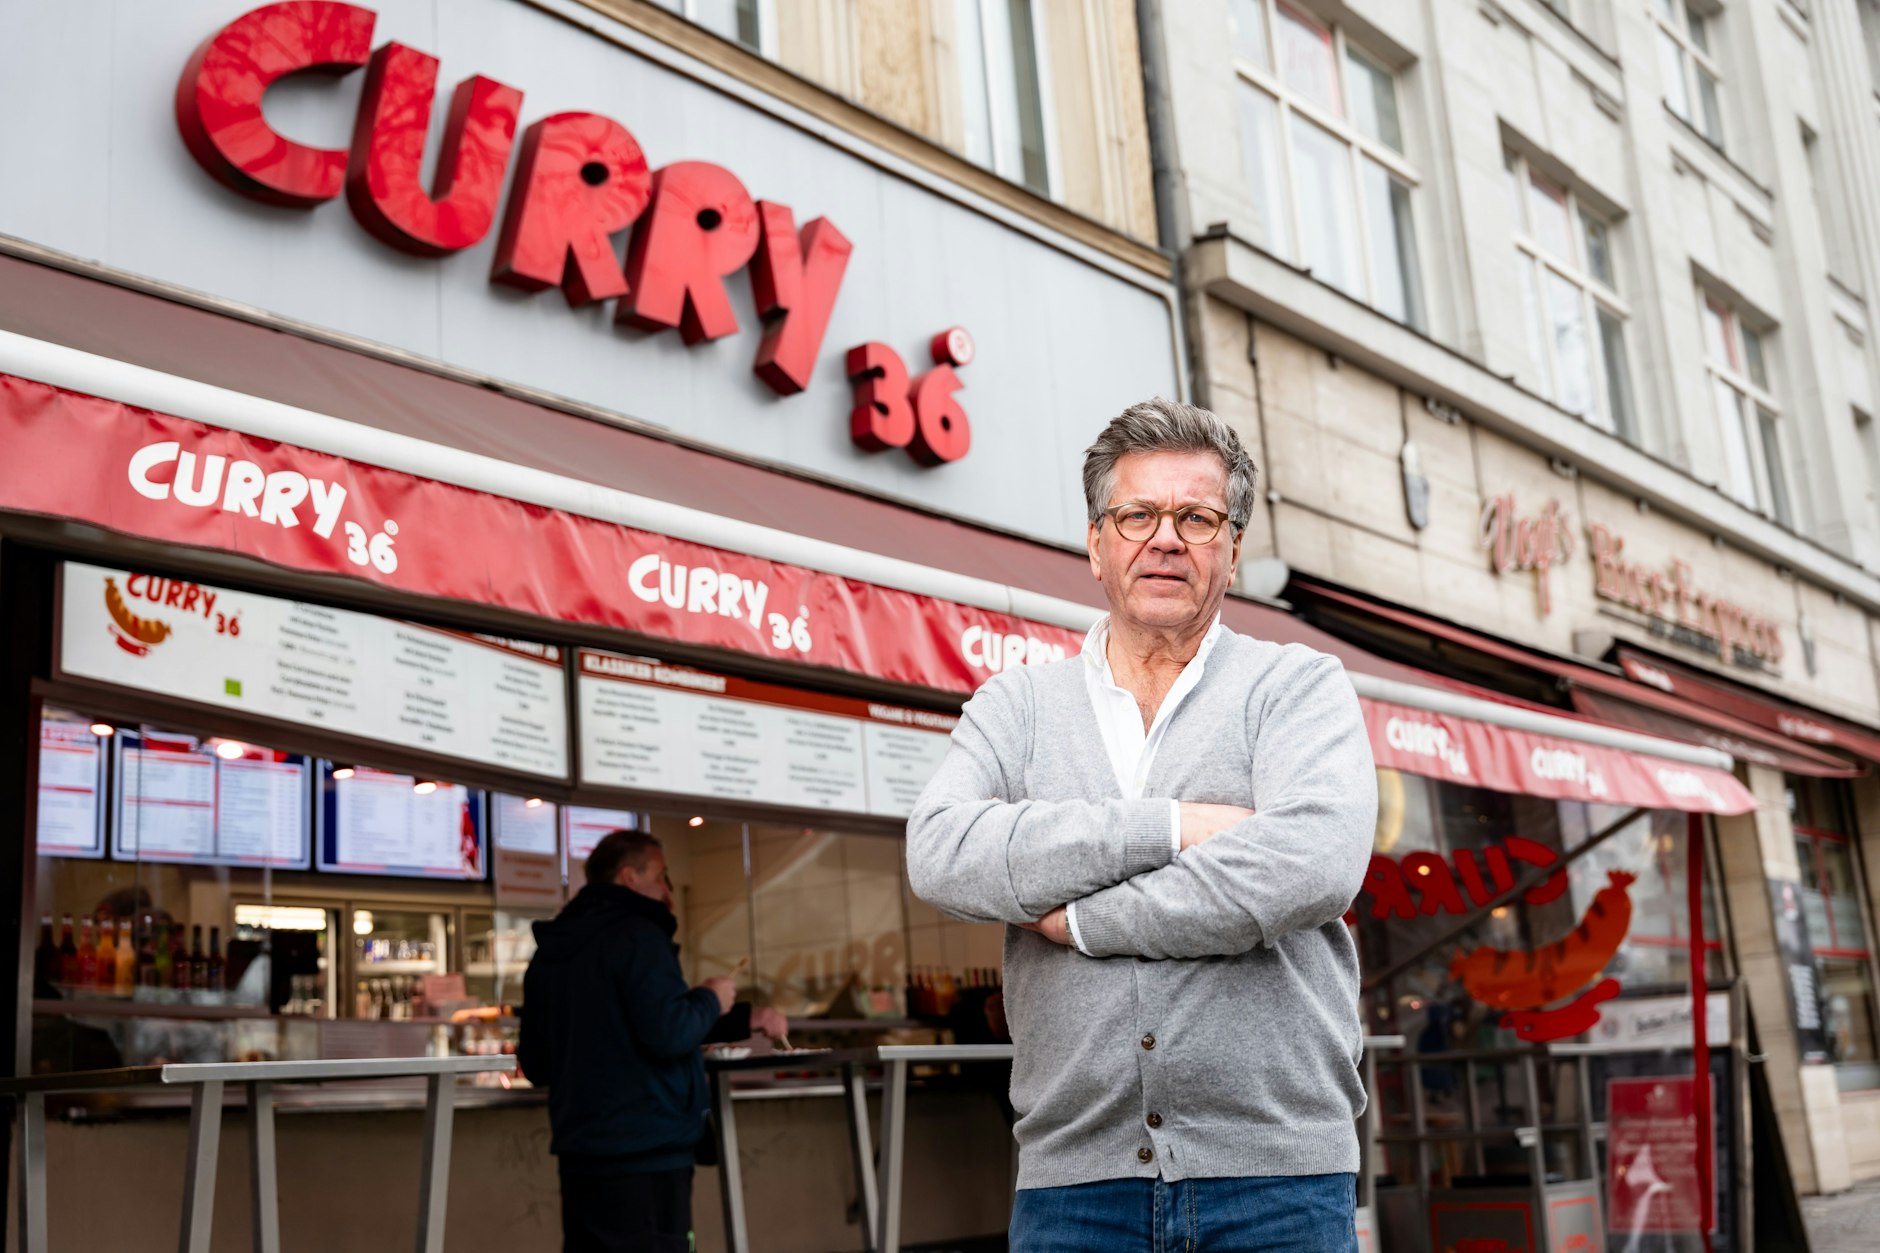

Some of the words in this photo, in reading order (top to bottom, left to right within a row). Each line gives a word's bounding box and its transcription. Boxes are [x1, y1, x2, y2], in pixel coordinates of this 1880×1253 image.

[176, 0, 854, 396] CURRY
[128, 441, 347, 539] CURRY
[127, 573, 217, 619] CURRY
[628, 554, 769, 630] CURRY
[1386, 716, 1450, 761] CURRY
[1531, 746, 1587, 784] CURRY
